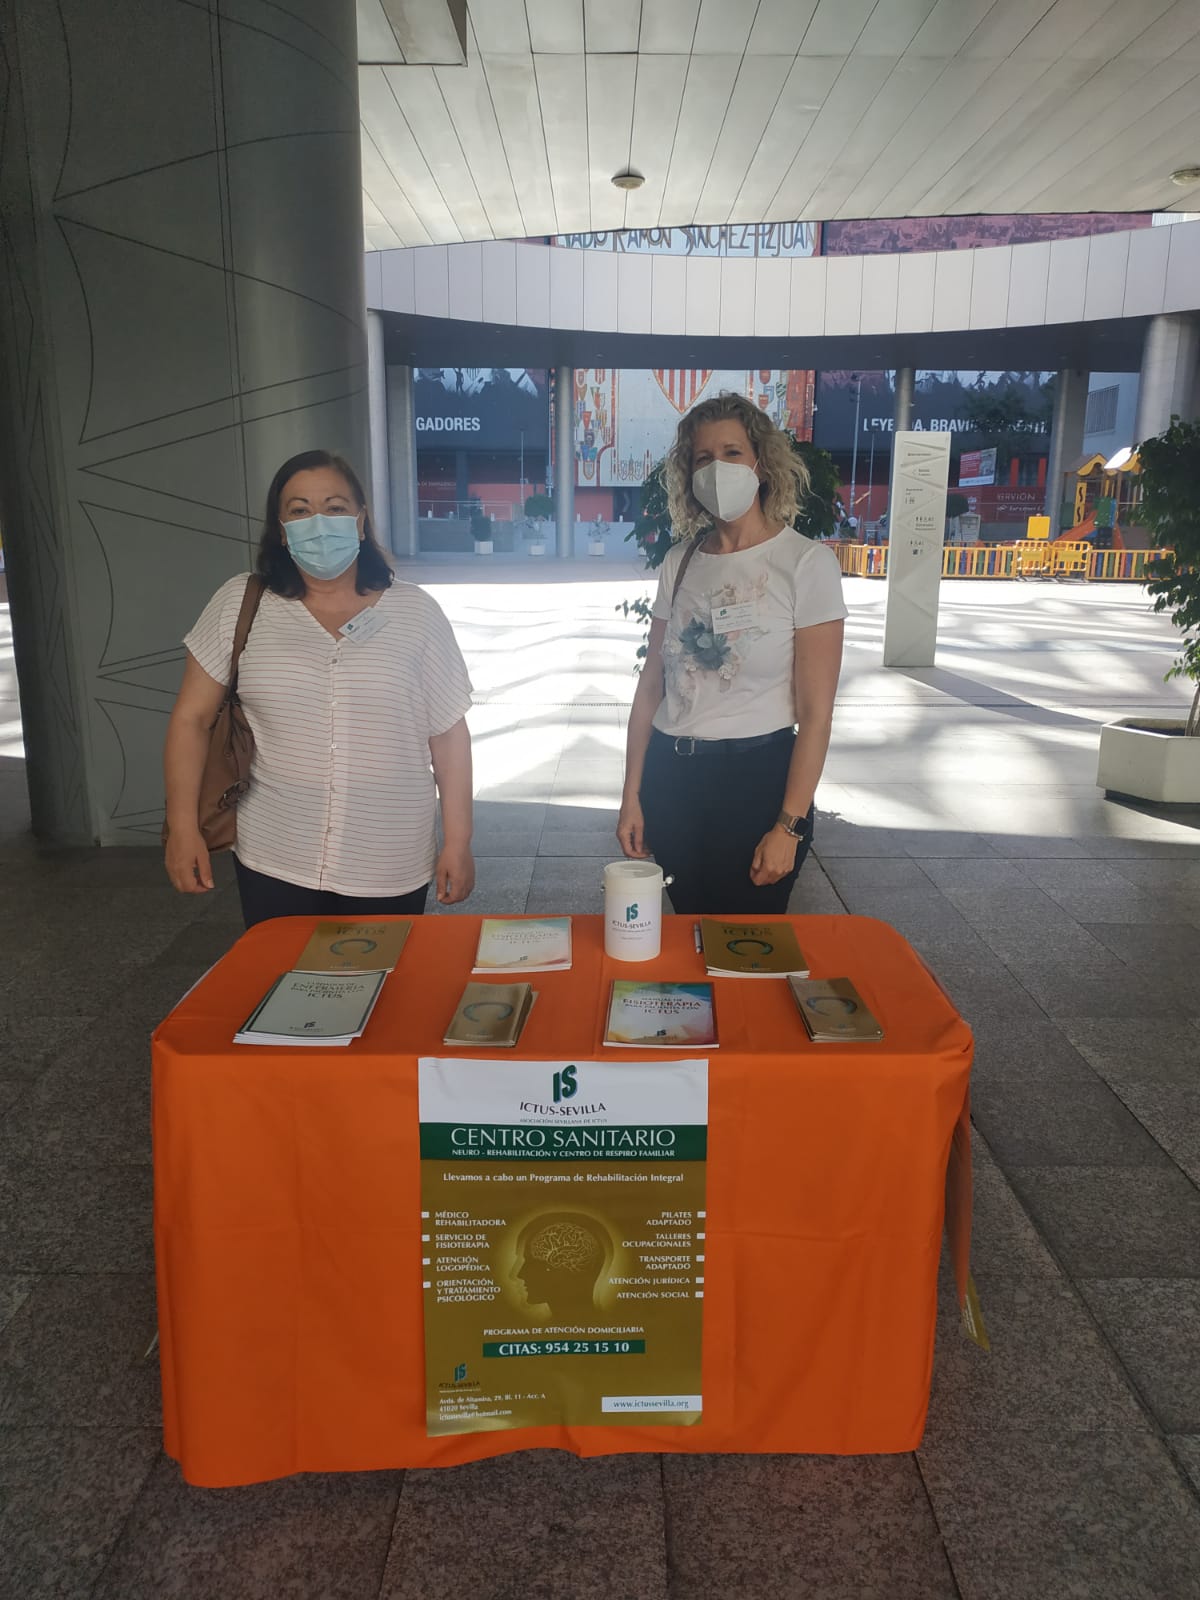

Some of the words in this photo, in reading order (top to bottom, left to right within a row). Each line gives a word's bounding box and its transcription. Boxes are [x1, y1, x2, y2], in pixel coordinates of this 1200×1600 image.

[415, 417, 480, 431] GADORES
[626, 903, 639, 922] IS
[553, 1064, 578, 1103] IS
[519, 1101, 607, 1116] ICTUS-SEVILLA
[451, 1128, 546, 1147] CENTRO
[553, 1129, 676, 1147] SANITARIO
[452, 1149, 481, 1157] NEURO
[487, 1149, 552, 1158] REHABILITACIÓN
[638, 1149, 676, 1157] FAMILIAR
[443, 1173, 483, 1181] Llevamos
[492, 1173, 514, 1182] cabo
[529, 1173, 571, 1184] Programa
[573, 1173, 585, 1182] de
[586, 1173, 648, 1182] Rehabilitación
[650, 1173, 684, 1184] Integral
[435, 1210, 470, 1219] MÉDICO
[435, 1219, 507, 1227] REHABILITADORA
[435, 1233, 474, 1241] SERVICIO
[435, 1241, 490, 1249] FISIOTERAPIA
[622, 1240, 692, 1248] OCUPACIONALES
[436, 1256, 479, 1264] ATENCIÓN
[639, 1255, 692, 1263] TRANSPORTE
[436, 1263, 491, 1272] LOGOPÉDICA
[436, 1278, 494, 1288] ORIENTACIÓN
[608, 1276, 651, 1285] ATENCIÓN
[652, 1276, 691, 1285] JURÍDICA
[444, 1286, 501, 1295] TRATAMIENTO
[616, 1291, 659, 1299] ATENCIÓN
[436, 1293, 496, 1303] PSICOLÓGICO
[483, 1328, 530, 1336] PROGRAMA
[531, 1327, 543, 1335] DE
[544, 1326, 586, 1334] ATENCIÓN
[587, 1326, 645, 1334] DOMICILIARIA
[499, 1343, 542, 1356] CITAS:
[545, 1342, 570, 1354] 954
[573, 1342, 590, 1353] 25
[594, 1342, 609, 1353] 15
[614, 1342, 630, 1353] 10
[613, 1399, 689, 1409] www.ictussevilla.org
